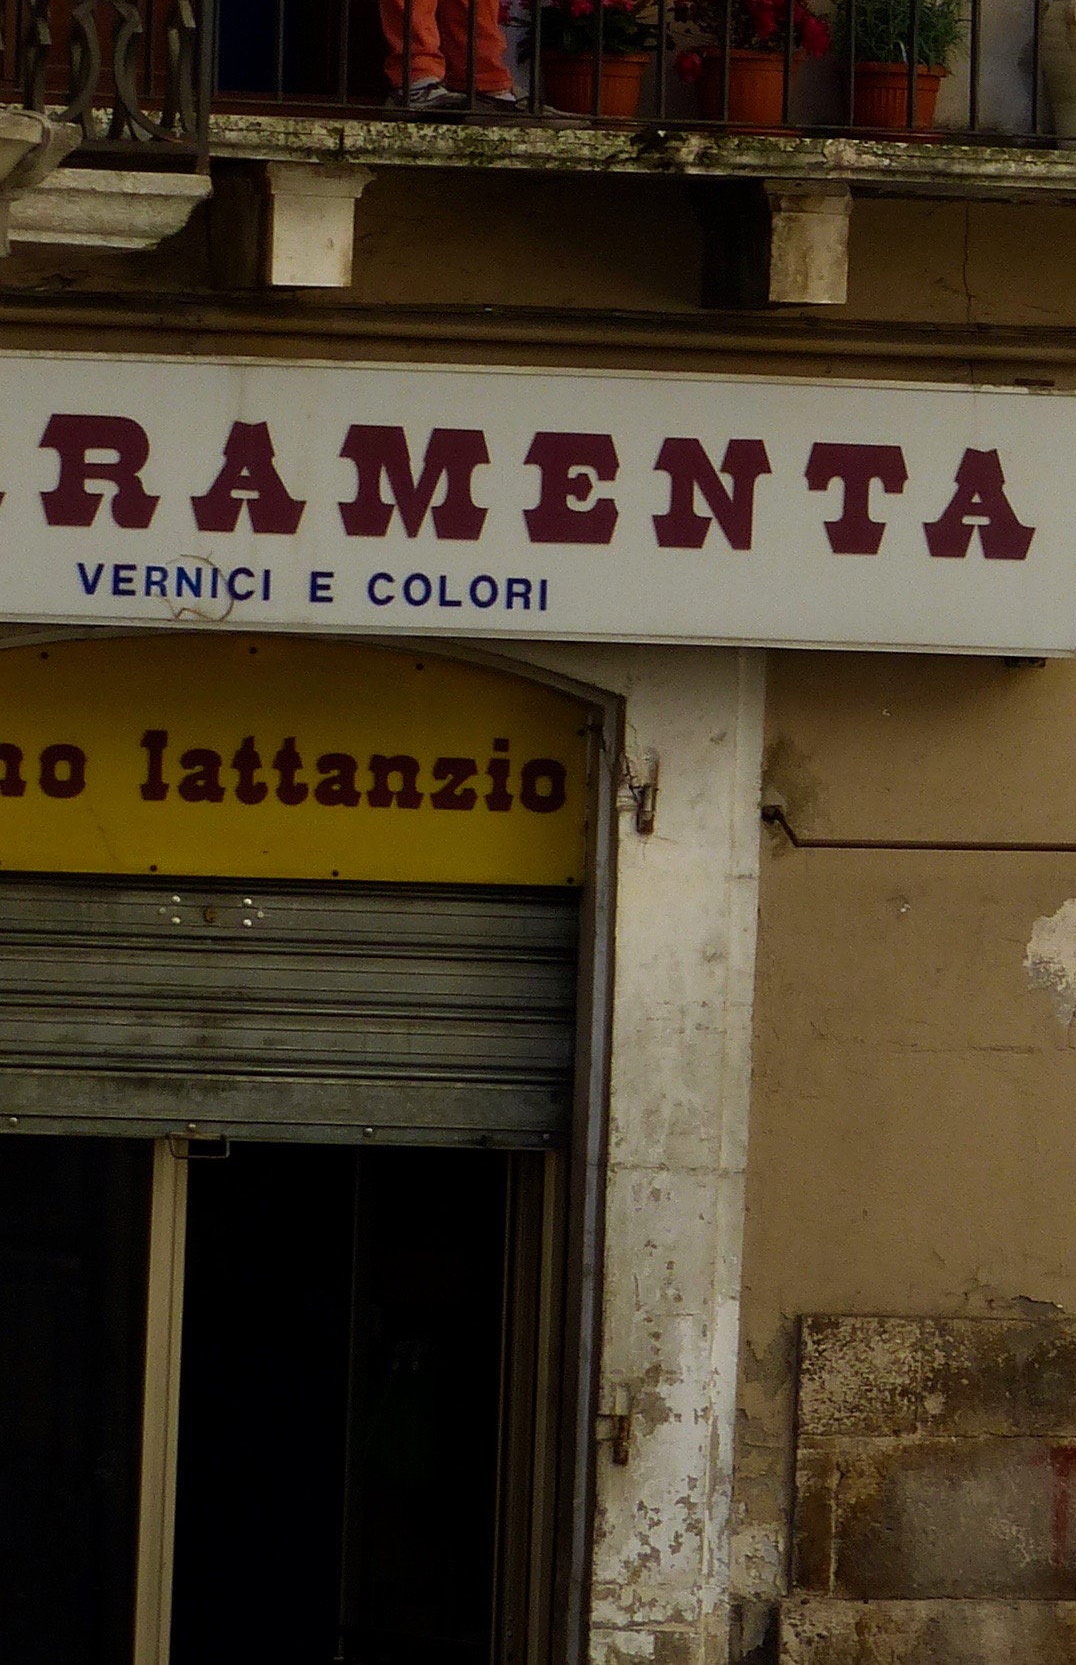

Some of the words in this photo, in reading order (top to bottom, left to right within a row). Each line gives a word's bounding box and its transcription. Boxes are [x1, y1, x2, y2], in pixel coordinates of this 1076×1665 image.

[0, 413, 1037, 561] RAMENTA
[77, 563, 272, 602] VERNICI
[310, 571, 335, 604] E
[367, 572, 549, 612] COLORI
